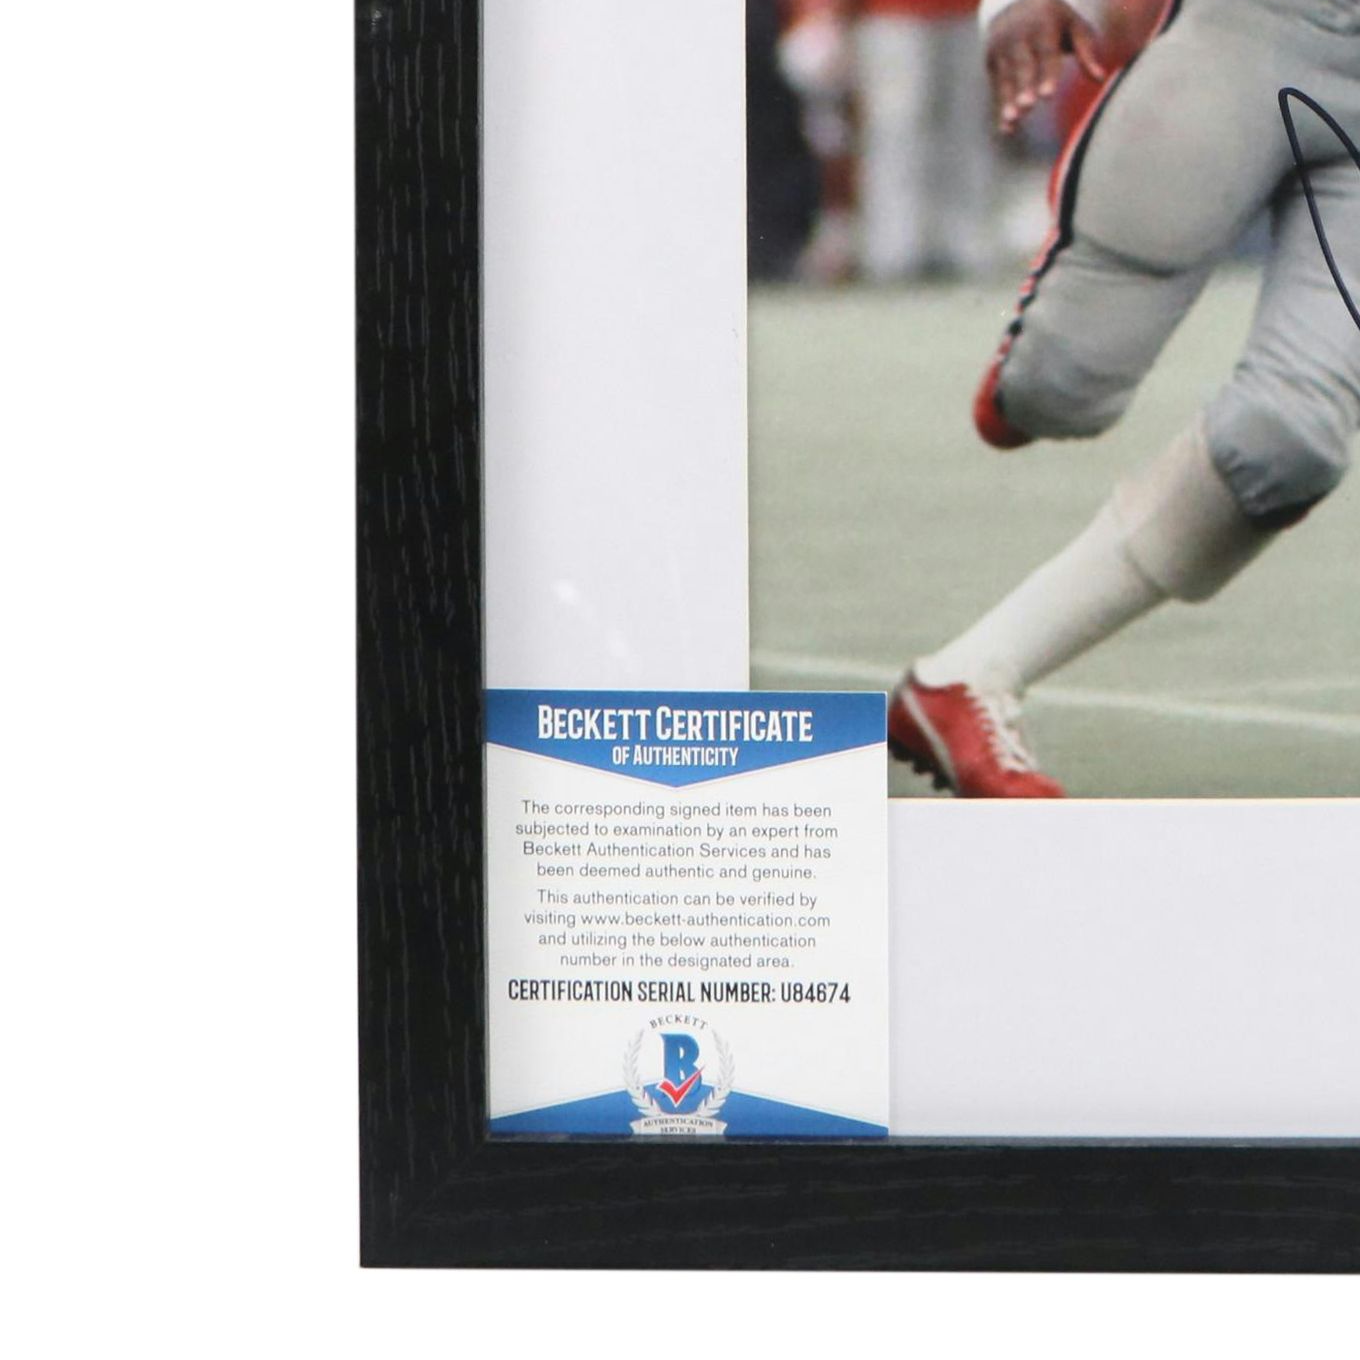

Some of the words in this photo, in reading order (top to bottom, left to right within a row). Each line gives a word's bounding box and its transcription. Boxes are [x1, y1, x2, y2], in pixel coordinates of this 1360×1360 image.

[537, 704, 652, 741] BECKETT
[655, 705, 814, 743] CERTIFICATE
[612, 745, 631, 766] OF
[632, 744, 739, 767] AUTHENTICITY
[520, 798, 550, 815] The
[554, 801, 666, 820] corresponding
[669, 802, 721, 820] signed
[725, 802, 758, 817] item
[762, 802, 790, 818] has
[793, 802, 832, 818] been
[514, 819, 590, 840] subjected
[594, 822, 609, 837] to
[612, 822, 702, 838] examination
[706, 822, 725, 840] by
[728, 826, 747, 838] an
[751, 825, 799, 840] expert
[804, 823, 839, 839] from
[522, 839, 582, 858] Beckett
[586, 841, 695, 858] Authentication
[699, 841, 767, 859] Services
[770, 843, 799, 859] and
[804, 844, 832, 859] has
[536, 861, 575, 877] been
[578, 862, 641, 878] deemed
[644, 863, 715, 879] authentic
[718, 863, 748, 879] and
[751, 865, 817, 883] genuine.
[536, 888, 569, 905] This
[572, 890, 679, 906] authentication
[683, 894, 711, 906] can
[715, 891, 735, 907] be
[739, 891, 795, 907] verified
[799, 891, 818, 911] by
[523, 909, 576, 929] visiting
[580, 908, 831, 928] www.beckett-authentication.com
[538, 930, 567, 946] and
[571, 931, 628, 951] utilizing
[631, 931, 656, 947] the
[659, 931, 706, 947] below
[709, 932, 816, 949] authentication
[560, 951, 617, 967] number
[622, 951, 635, 967] in
[639, 952, 664, 968] the
[667, 952, 752, 972] designated
[756, 956, 794, 969] area.
[508, 978, 633, 1002] CERTIFICATION
[637, 980, 696, 1003] SERIAL
[700, 981, 776, 1003] NUMBER:
[780, 982, 851, 1004] U84674
[648, 1014, 708, 1029] BECKETT
